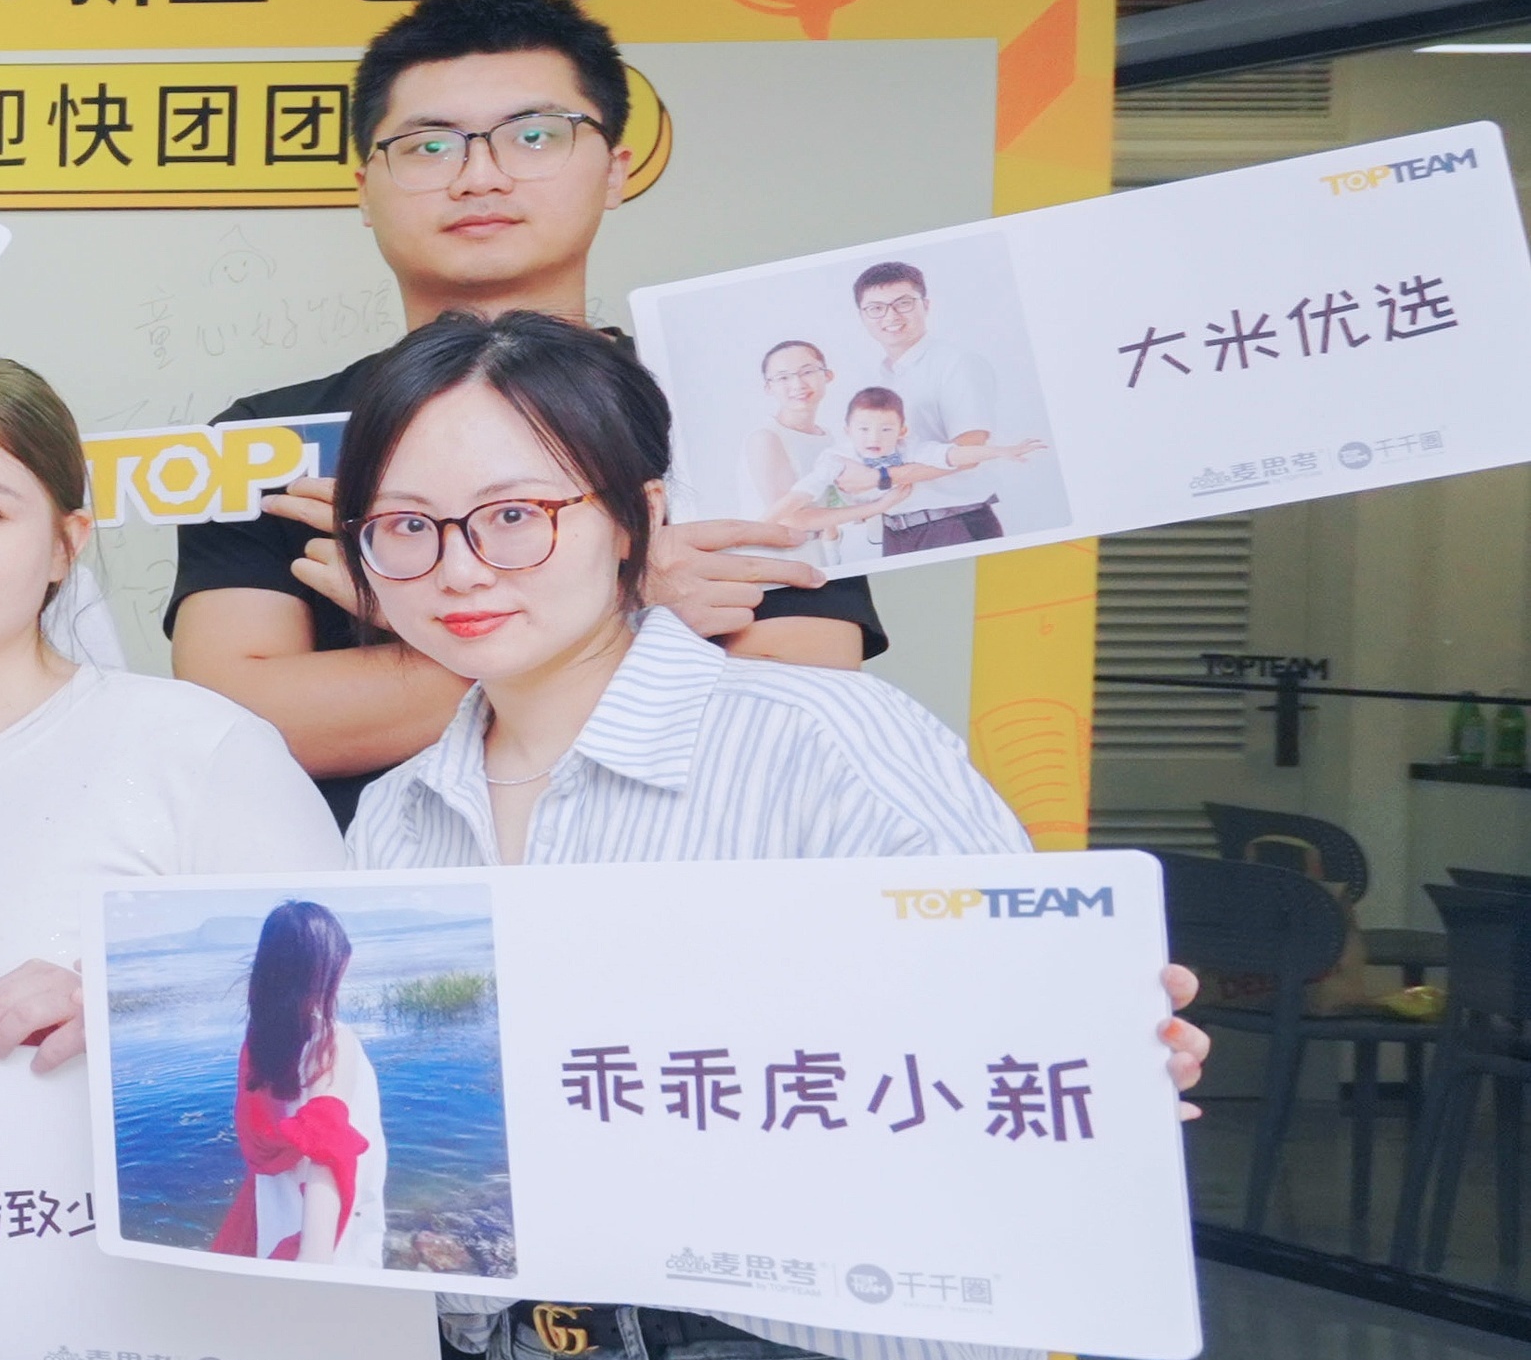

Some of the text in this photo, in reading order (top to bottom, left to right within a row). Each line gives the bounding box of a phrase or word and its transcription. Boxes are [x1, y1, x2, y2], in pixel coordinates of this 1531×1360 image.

[1320, 148, 1478, 197] TOPTEAM
[1118, 275, 1460, 389] 大米优选
[882, 886, 1115, 919] TOPTEAM
[562, 1045, 1094, 1143] 乖乖虎小新
